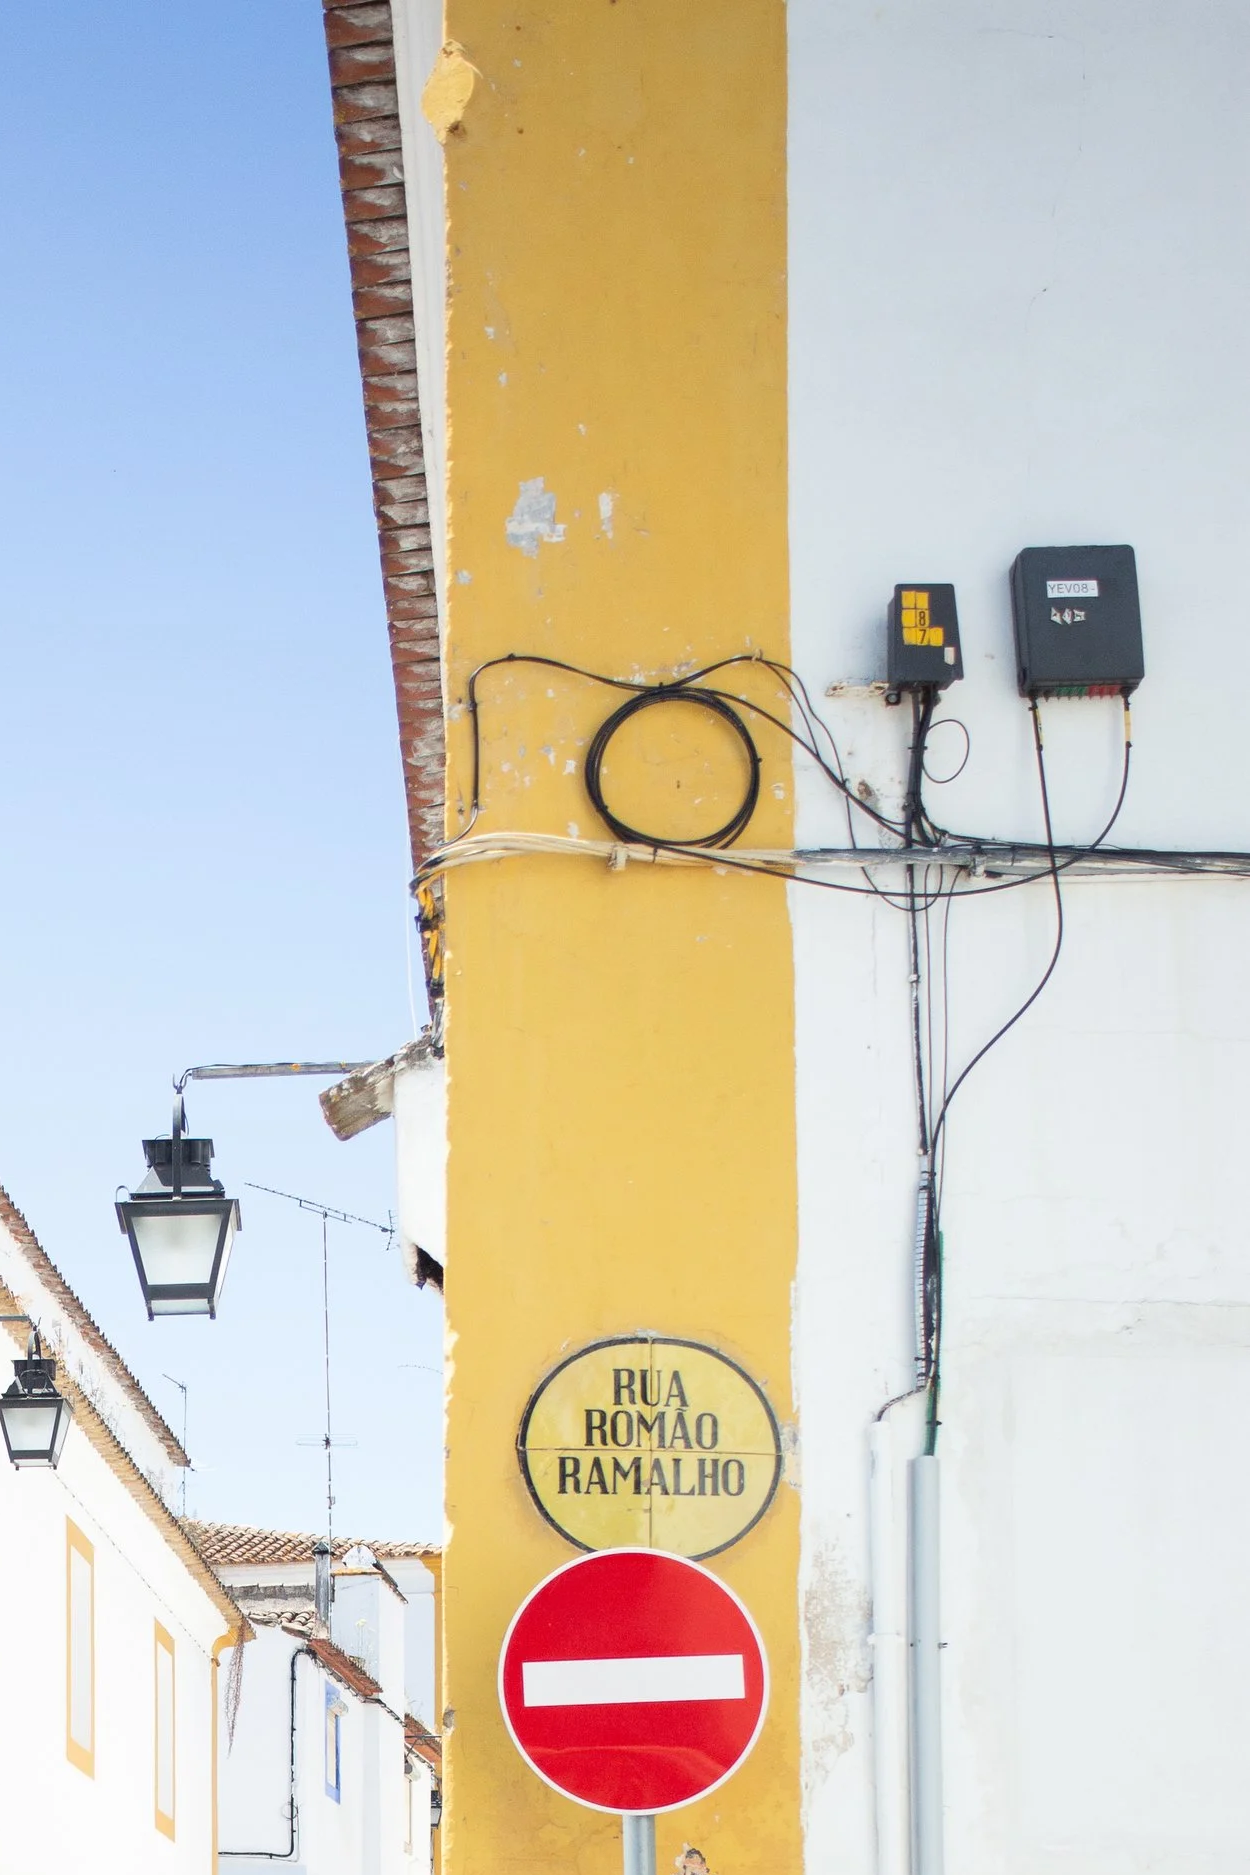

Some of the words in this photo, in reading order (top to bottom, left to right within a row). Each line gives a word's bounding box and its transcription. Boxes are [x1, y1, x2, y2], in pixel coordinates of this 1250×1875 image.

[918, 610, 926, 626] 8
[918, 629, 927, 645] 7
[612, 1368, 689, 1407] RUA
[584, 1408, 719, 1450] ROMÃO
[557, 1456, 745, 1496] RAMALHO
